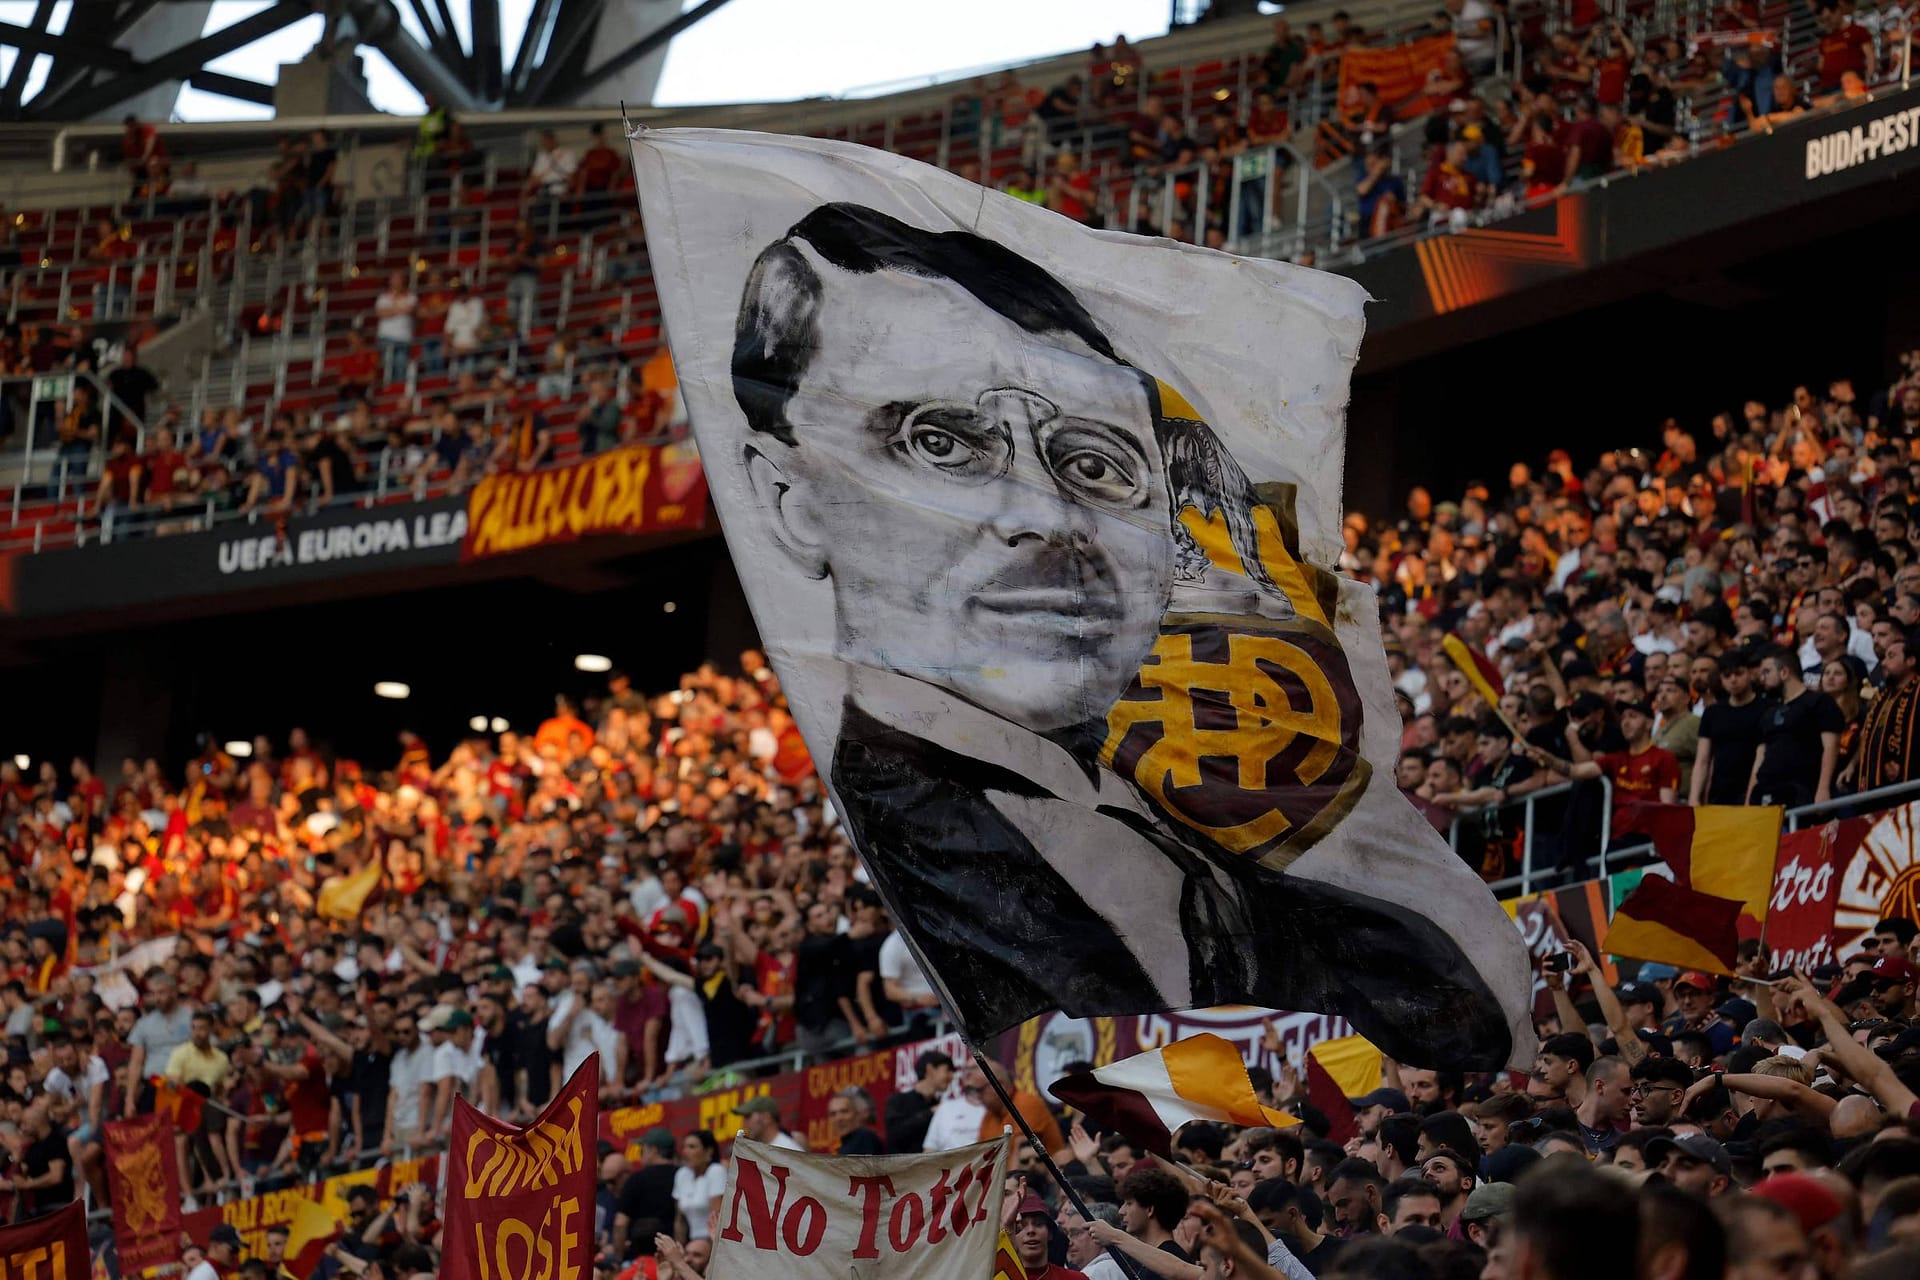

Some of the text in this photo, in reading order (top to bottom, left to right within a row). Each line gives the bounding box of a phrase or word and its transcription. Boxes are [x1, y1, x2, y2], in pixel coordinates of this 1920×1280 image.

[218, 534, 294, 574] UEFA
[298, 517, 409, 564] EUROPA
[721, 1144, 1003, 1259] No Totti
